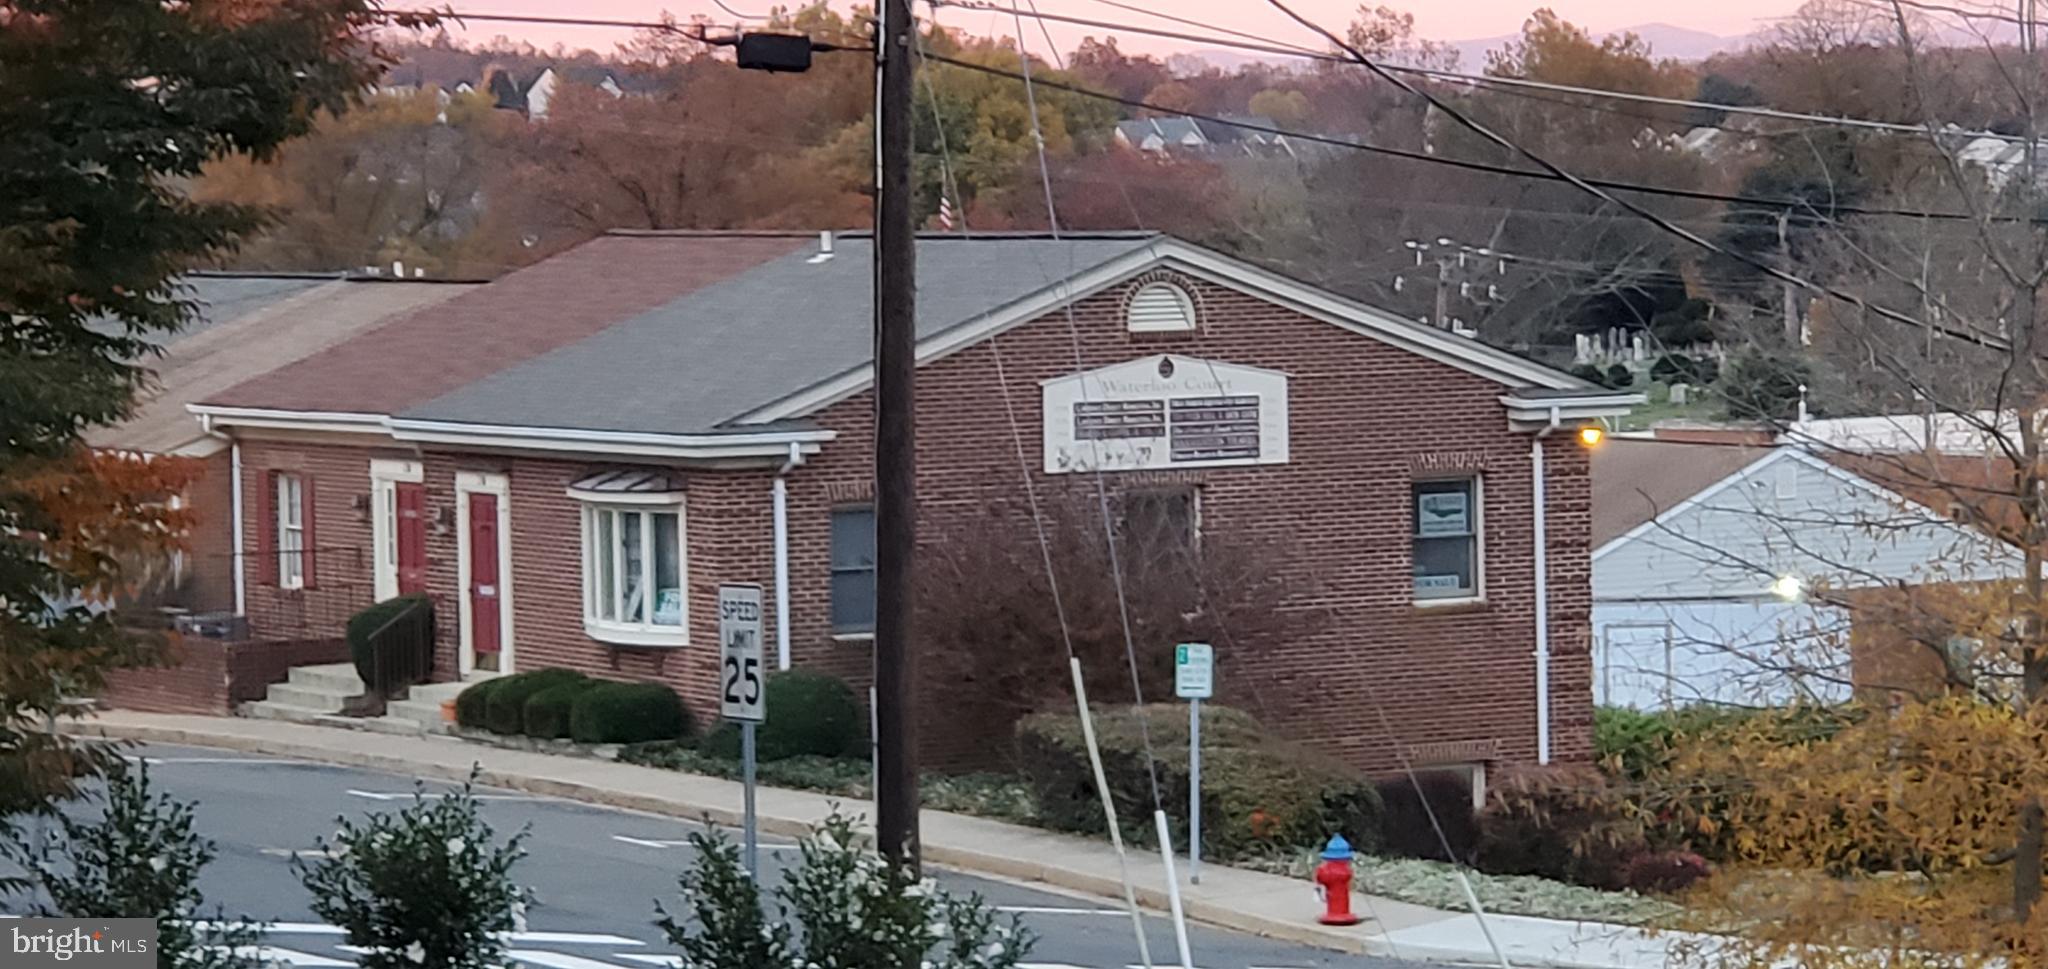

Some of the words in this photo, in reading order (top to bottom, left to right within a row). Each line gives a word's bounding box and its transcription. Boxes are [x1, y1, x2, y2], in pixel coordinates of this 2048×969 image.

[1102, 378, 1177, 394] Waterloo
[1184, 377, 1233, 391] Court
[722, 600, 758, 621] SPEED
[727, 629, 756, 649] LIMIT
[724, 656, 760, 706] 25
